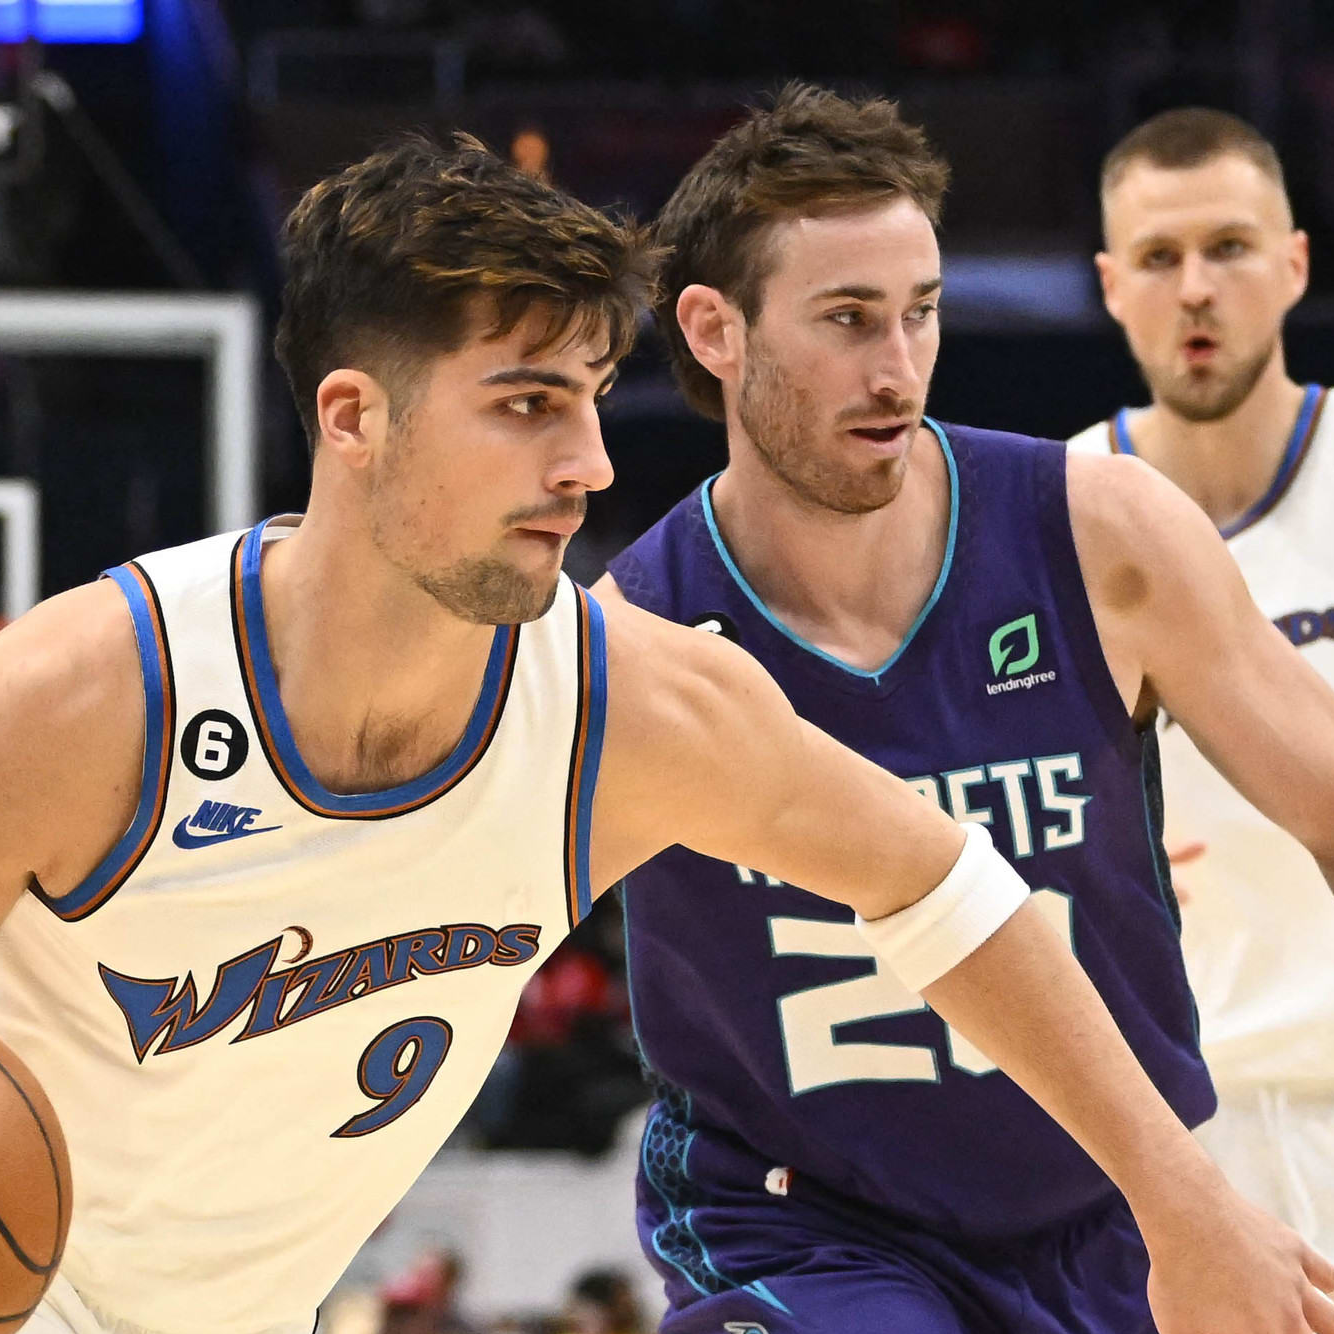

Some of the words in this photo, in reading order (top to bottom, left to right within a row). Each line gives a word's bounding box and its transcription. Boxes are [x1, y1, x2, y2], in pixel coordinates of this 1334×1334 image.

[986, 670, 1056, 696] lendingtree
[195, 720, 233, 773] 6
[189, 799, 263, 835] NIKE
[767, 886, 1074, 1098] 2
[328, 1015, 454, 1139] 9
